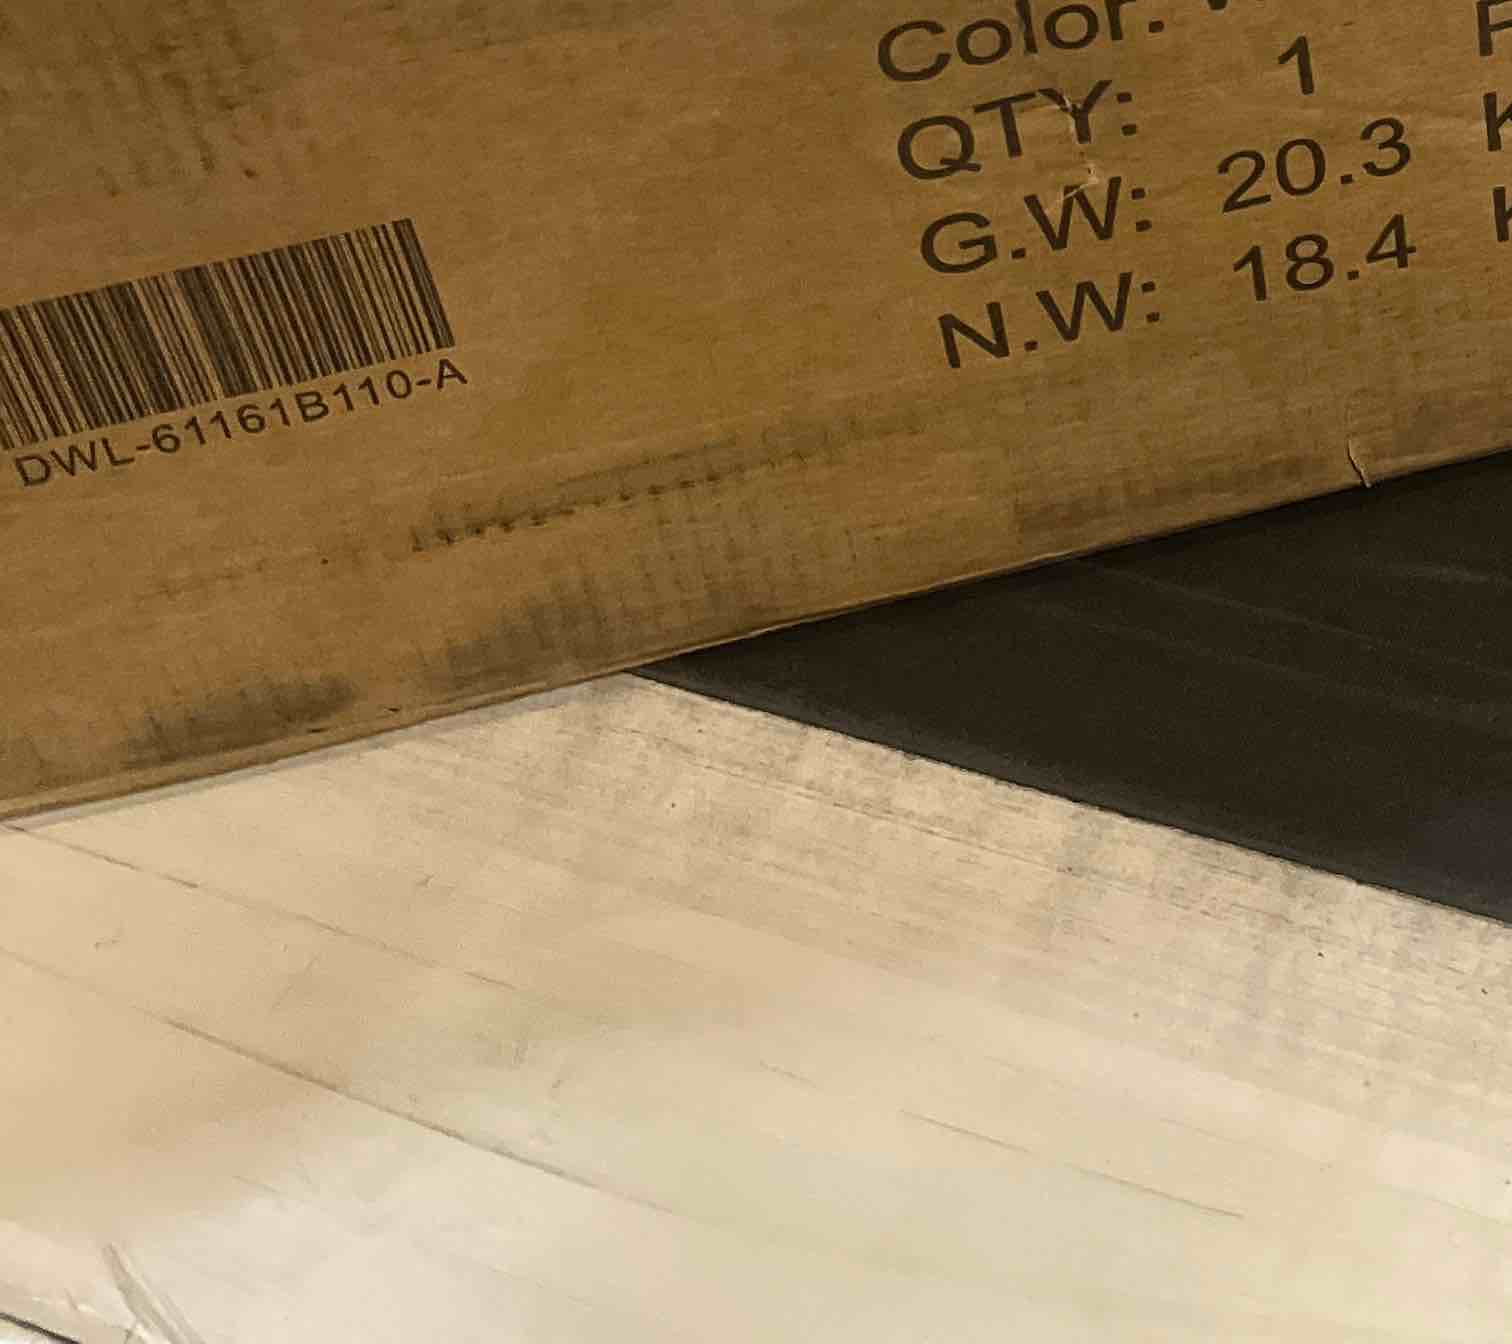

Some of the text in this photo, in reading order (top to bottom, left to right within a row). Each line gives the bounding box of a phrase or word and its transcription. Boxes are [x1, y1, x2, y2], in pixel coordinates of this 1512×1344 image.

[896, 78, 1139, 182] QTY:
[1276, 35, 1316, 96] 1
[919, 174, 1153, 276] G.W:
[1216, 116, 1413, 214] 20.3
[937, 271, 1161, 370] N.W:
[1231, 212, 1417, 303] 18.4
[14, 357, 469, 488] DWL-61161B110-A
